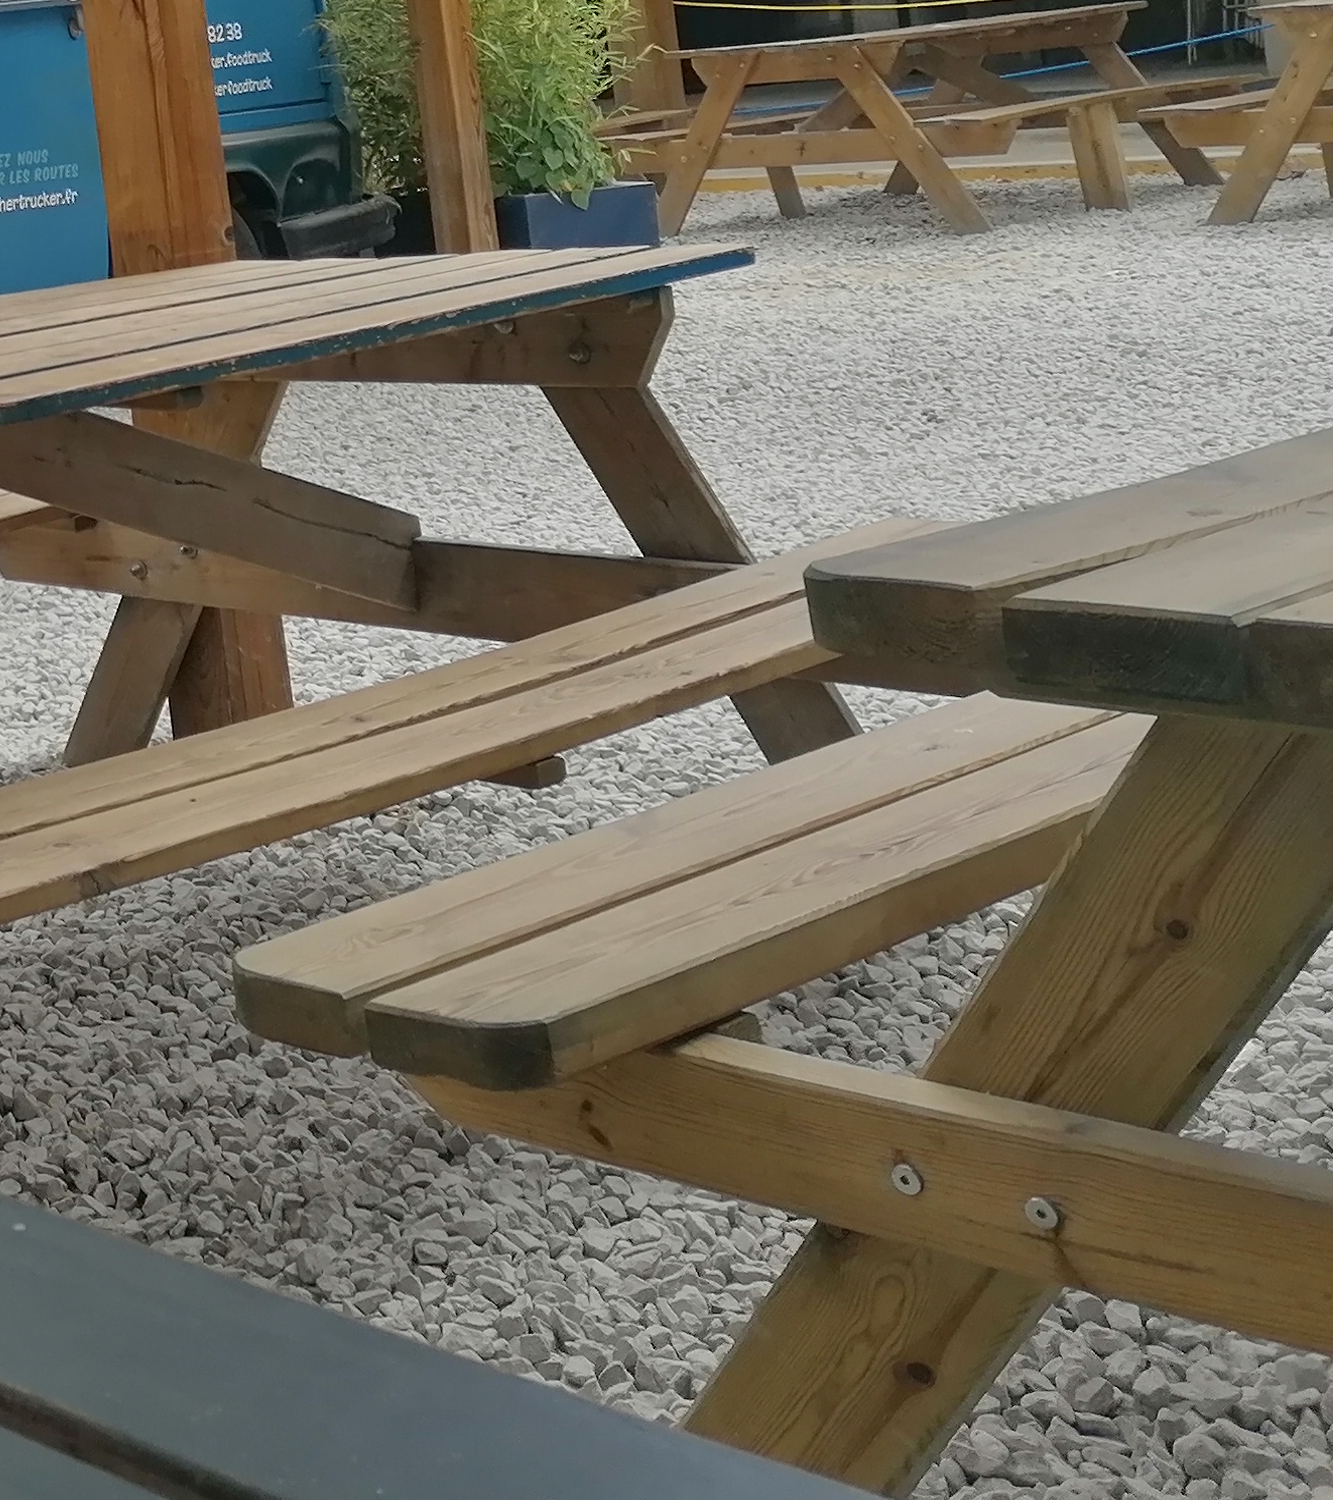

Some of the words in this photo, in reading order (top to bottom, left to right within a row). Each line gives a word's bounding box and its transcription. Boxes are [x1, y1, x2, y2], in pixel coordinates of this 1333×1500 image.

[207, 24, 225, 43] 82
[226, 22, 243, 41] 38
[17, 149, 49, 166] NOUS
[9, 169, 30, 185] LES
[34, 163, 79, 182] ROUTES
